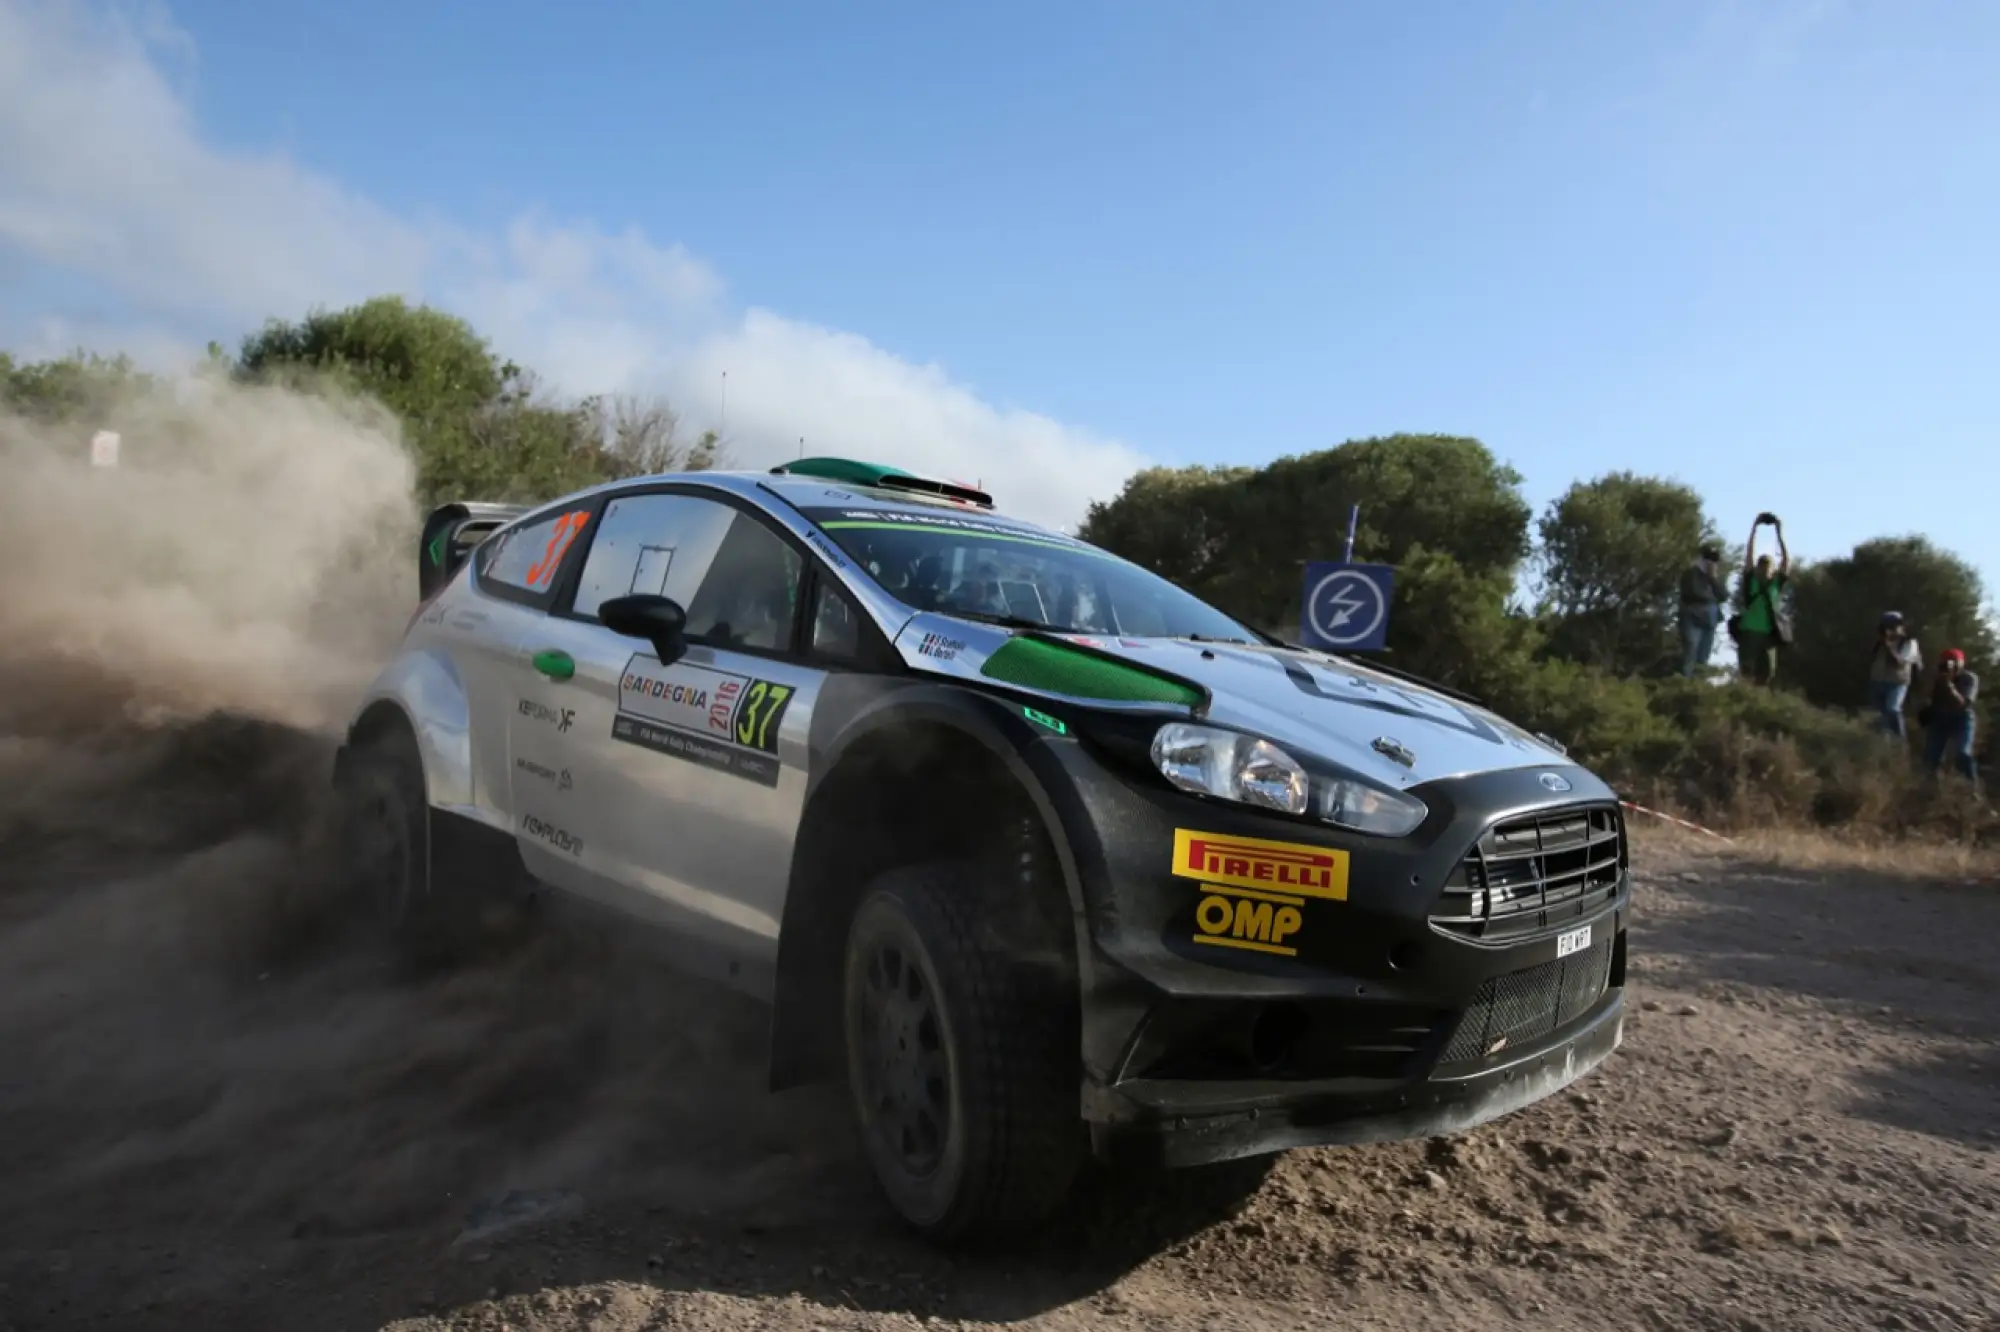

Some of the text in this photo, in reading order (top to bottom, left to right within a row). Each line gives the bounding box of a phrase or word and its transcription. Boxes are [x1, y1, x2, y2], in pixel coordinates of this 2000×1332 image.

[526, 511, 591, 585] 37
[623, 673, 707, 709] SARDEGNA
[709, 680, 740, 731] 2016
[738, 682, 789, 749] 37
[1189, 839, 1334, 888] PIRELLI
[1196, 895, 1302, 943] OMP
